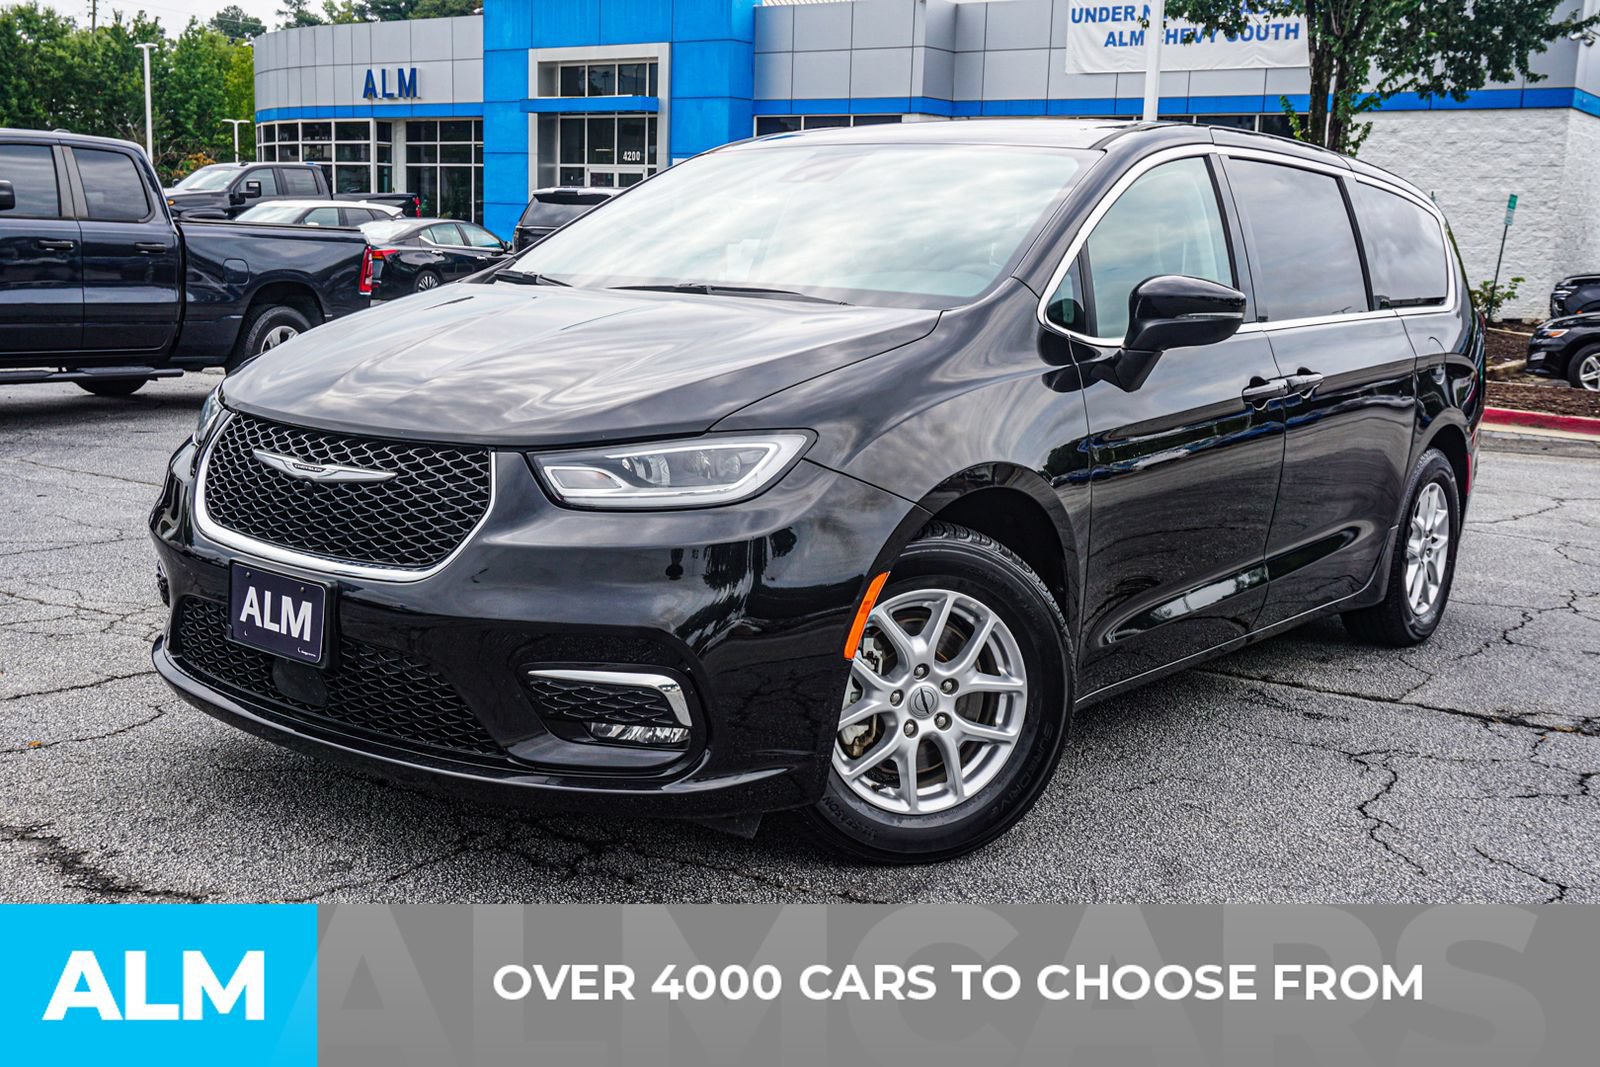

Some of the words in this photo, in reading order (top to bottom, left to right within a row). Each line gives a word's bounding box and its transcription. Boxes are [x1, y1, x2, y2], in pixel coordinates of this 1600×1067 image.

[1071, 5, 1136, 23] UNDER
[1104, 30, 1145, 47] ALM
[363, 68, 417, 98] ALM
[623, 151, 641, 161] 4200
[239, 585, 312, 641] ALM
